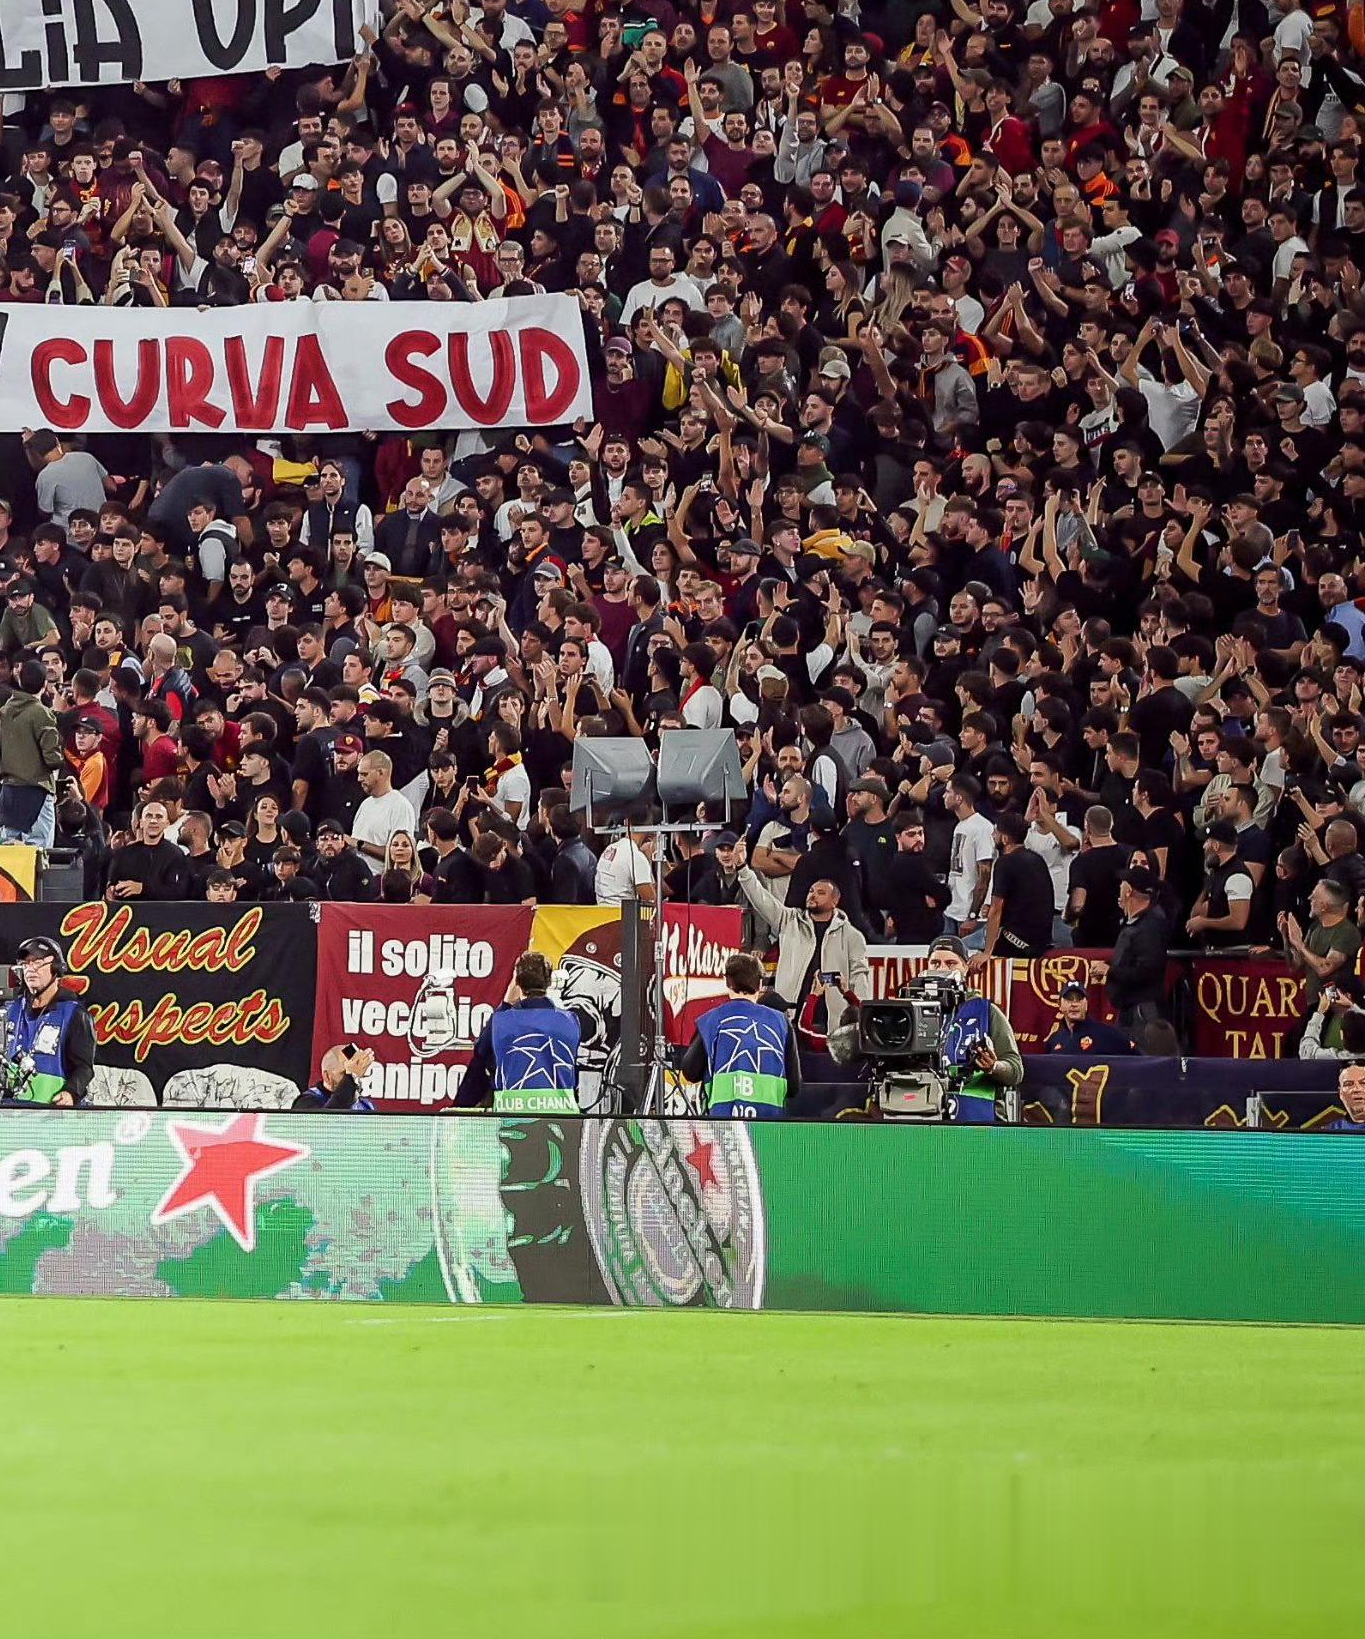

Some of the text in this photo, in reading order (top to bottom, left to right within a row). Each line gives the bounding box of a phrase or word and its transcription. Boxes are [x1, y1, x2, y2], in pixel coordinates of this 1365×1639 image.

[31, 333, 349, 431] CURVA
[385, 327, 580, 429] SUD
[60, 901, 264, 974] Usual
[347, 929, 494, 978] il solito
[60, 975, 290, 1063] uspects
[342, 996, 495, 1039] veccio
[366, 1057, 469, 1105] anipo
